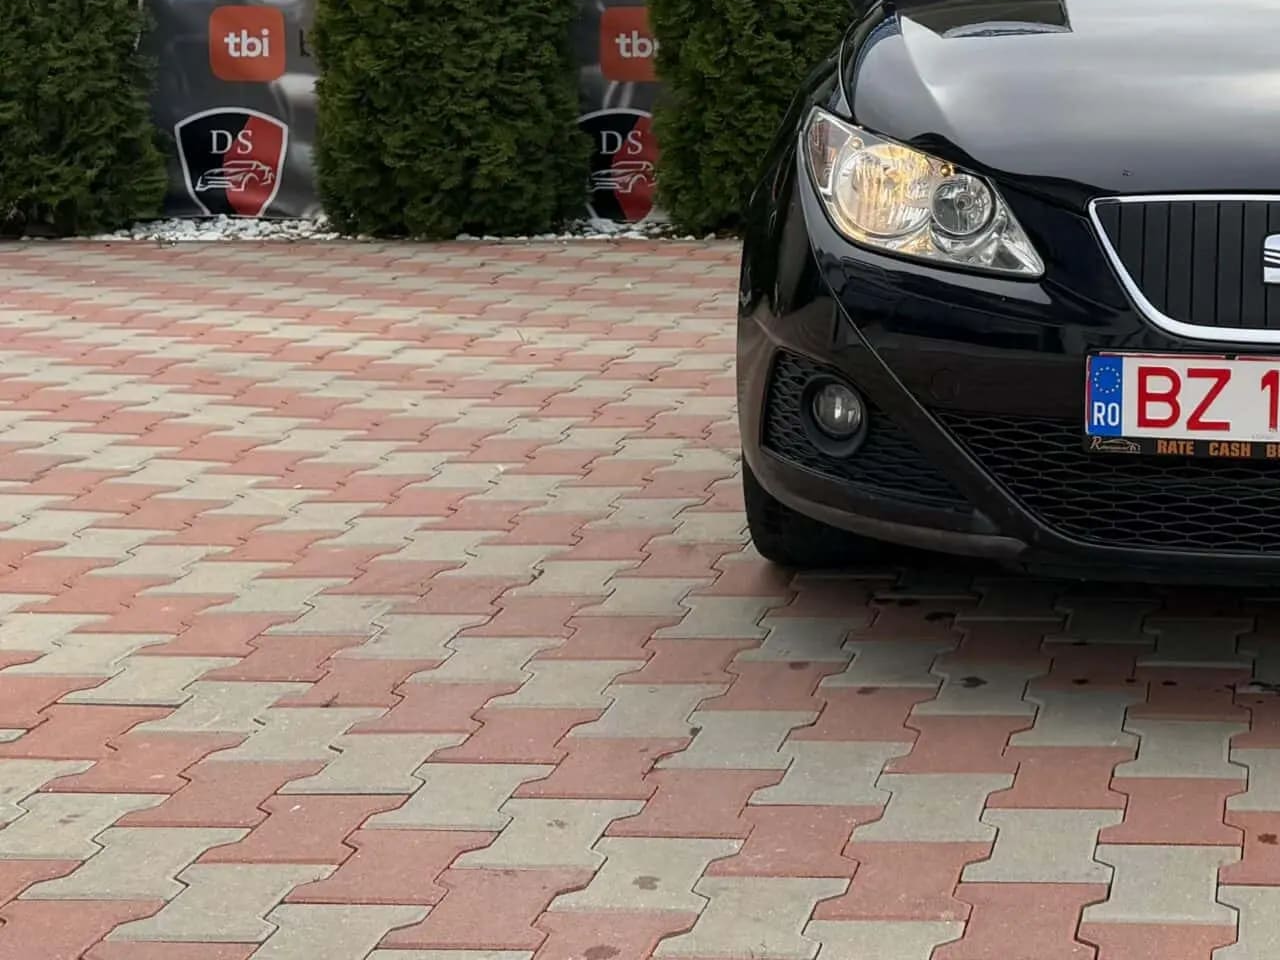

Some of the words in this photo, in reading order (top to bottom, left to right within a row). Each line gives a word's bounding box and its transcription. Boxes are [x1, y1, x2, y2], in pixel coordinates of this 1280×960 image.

[224, 26, 270, 57] tbi
[210, 129, 253, 154] DS
[600, 129, 643, 155] DS
[1093, 401, 1120, 426] RO
[1136, 365, 1232, 432] BZ
[1157, 439, 1195, 455] RATE
[1208, 441, 1251, 457] CASH
